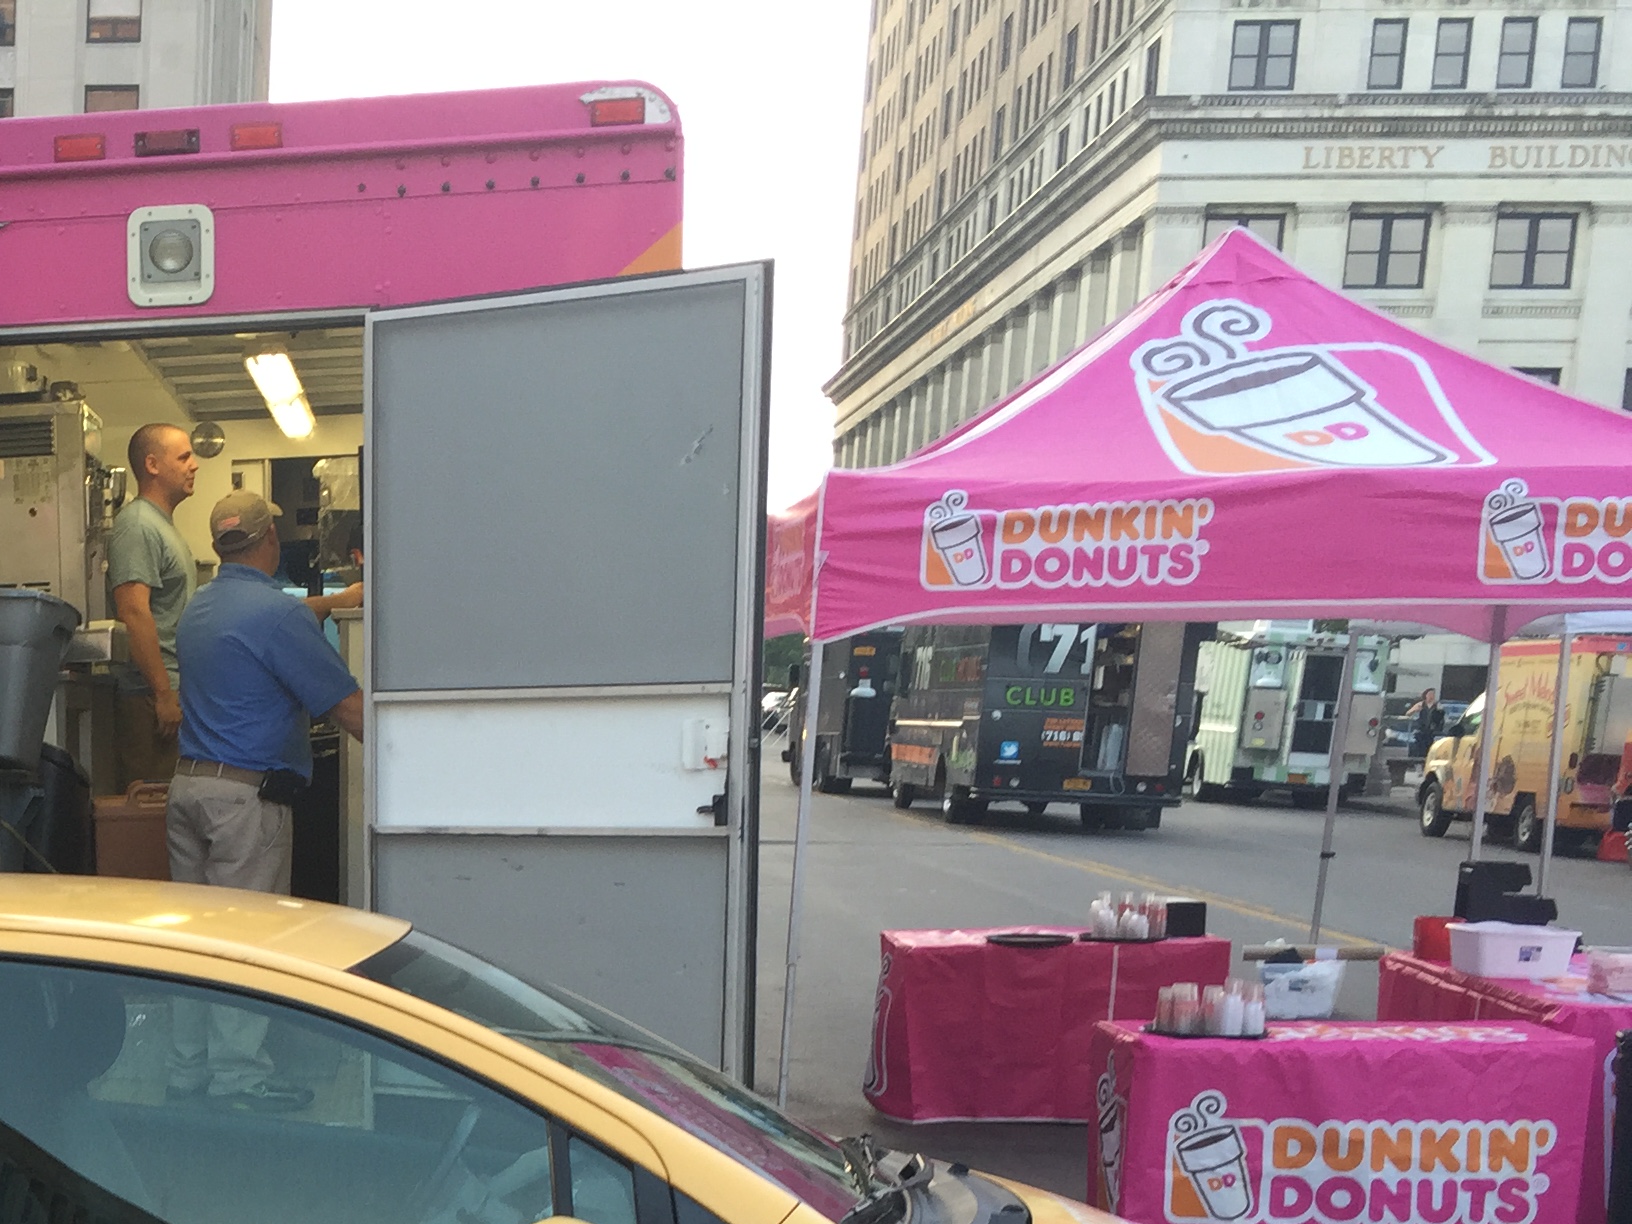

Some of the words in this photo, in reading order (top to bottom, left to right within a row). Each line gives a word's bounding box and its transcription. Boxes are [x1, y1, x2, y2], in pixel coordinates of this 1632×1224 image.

[1302, 145, 1445, 170] LIBERTY
[1487, 144, 1632, 169] BUILDIN
[1001, 502, 1209, 545] DUNKIN'
[999, 543, 1195, 585] DONUTS
[1006, 686, 1075, 707] CLUB
[1271, 1125, 1551, 1174] DUNKIN'
[1268, 1175, 1531, 1224] DONUTS
